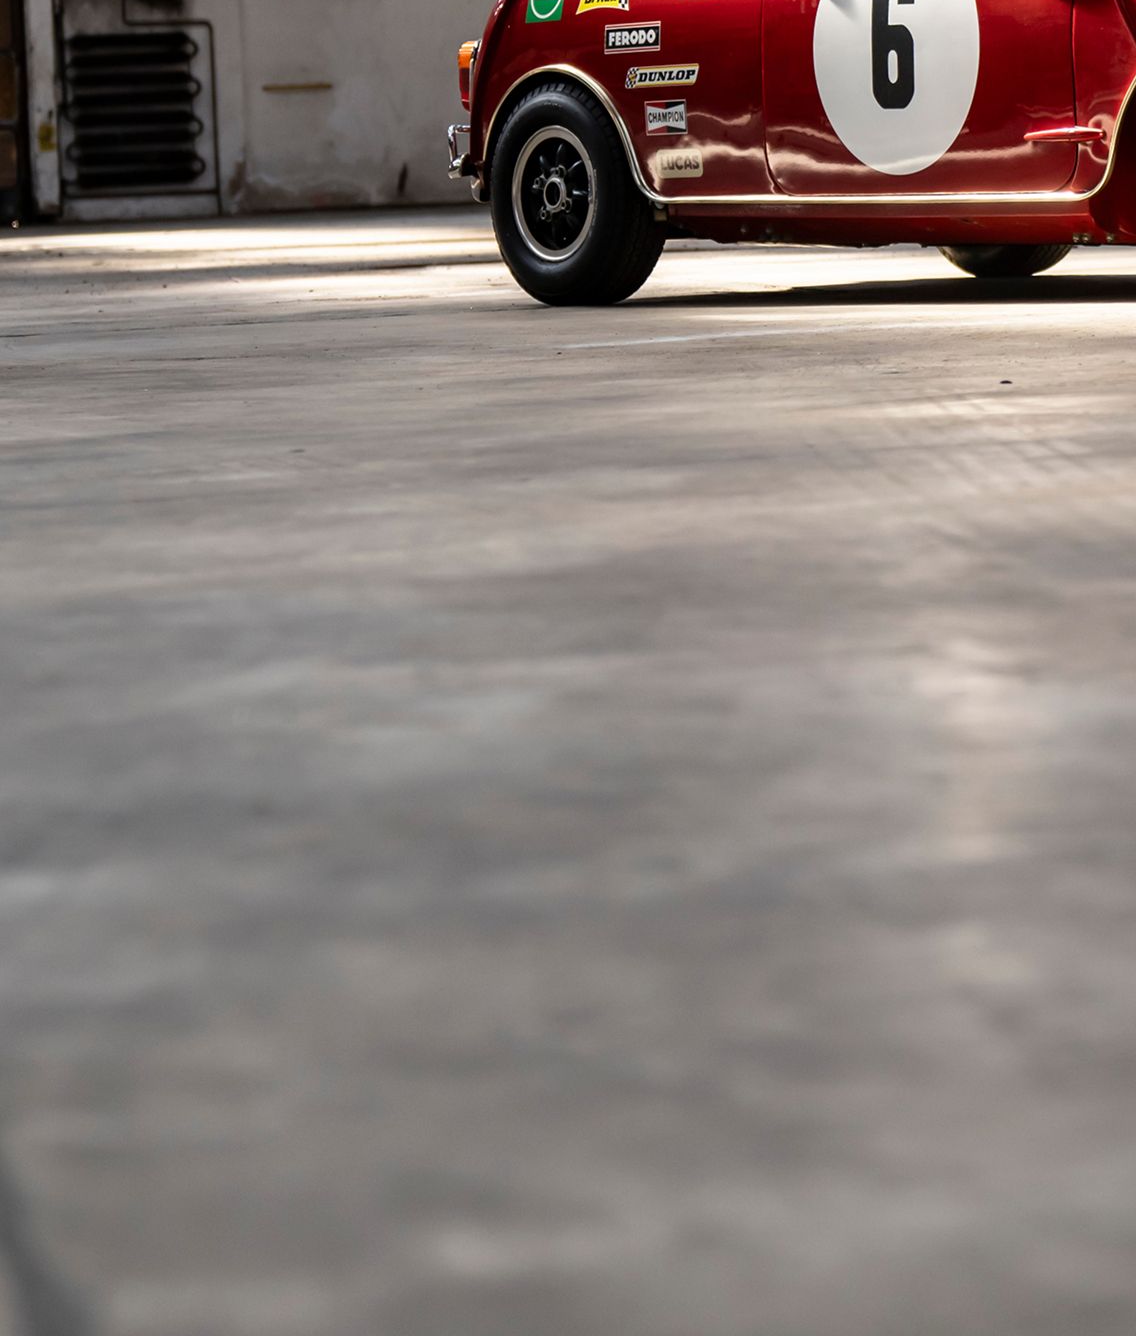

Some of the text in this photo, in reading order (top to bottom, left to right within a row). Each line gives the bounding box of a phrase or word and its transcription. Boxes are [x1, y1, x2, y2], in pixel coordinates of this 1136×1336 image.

[608, 29, 656, 47] FERODO
[637, 69, 696, 83] DUNLOP
[648, 111, 684, 124] CHAMPION
[660, 155, 700, 171] LUCAS
